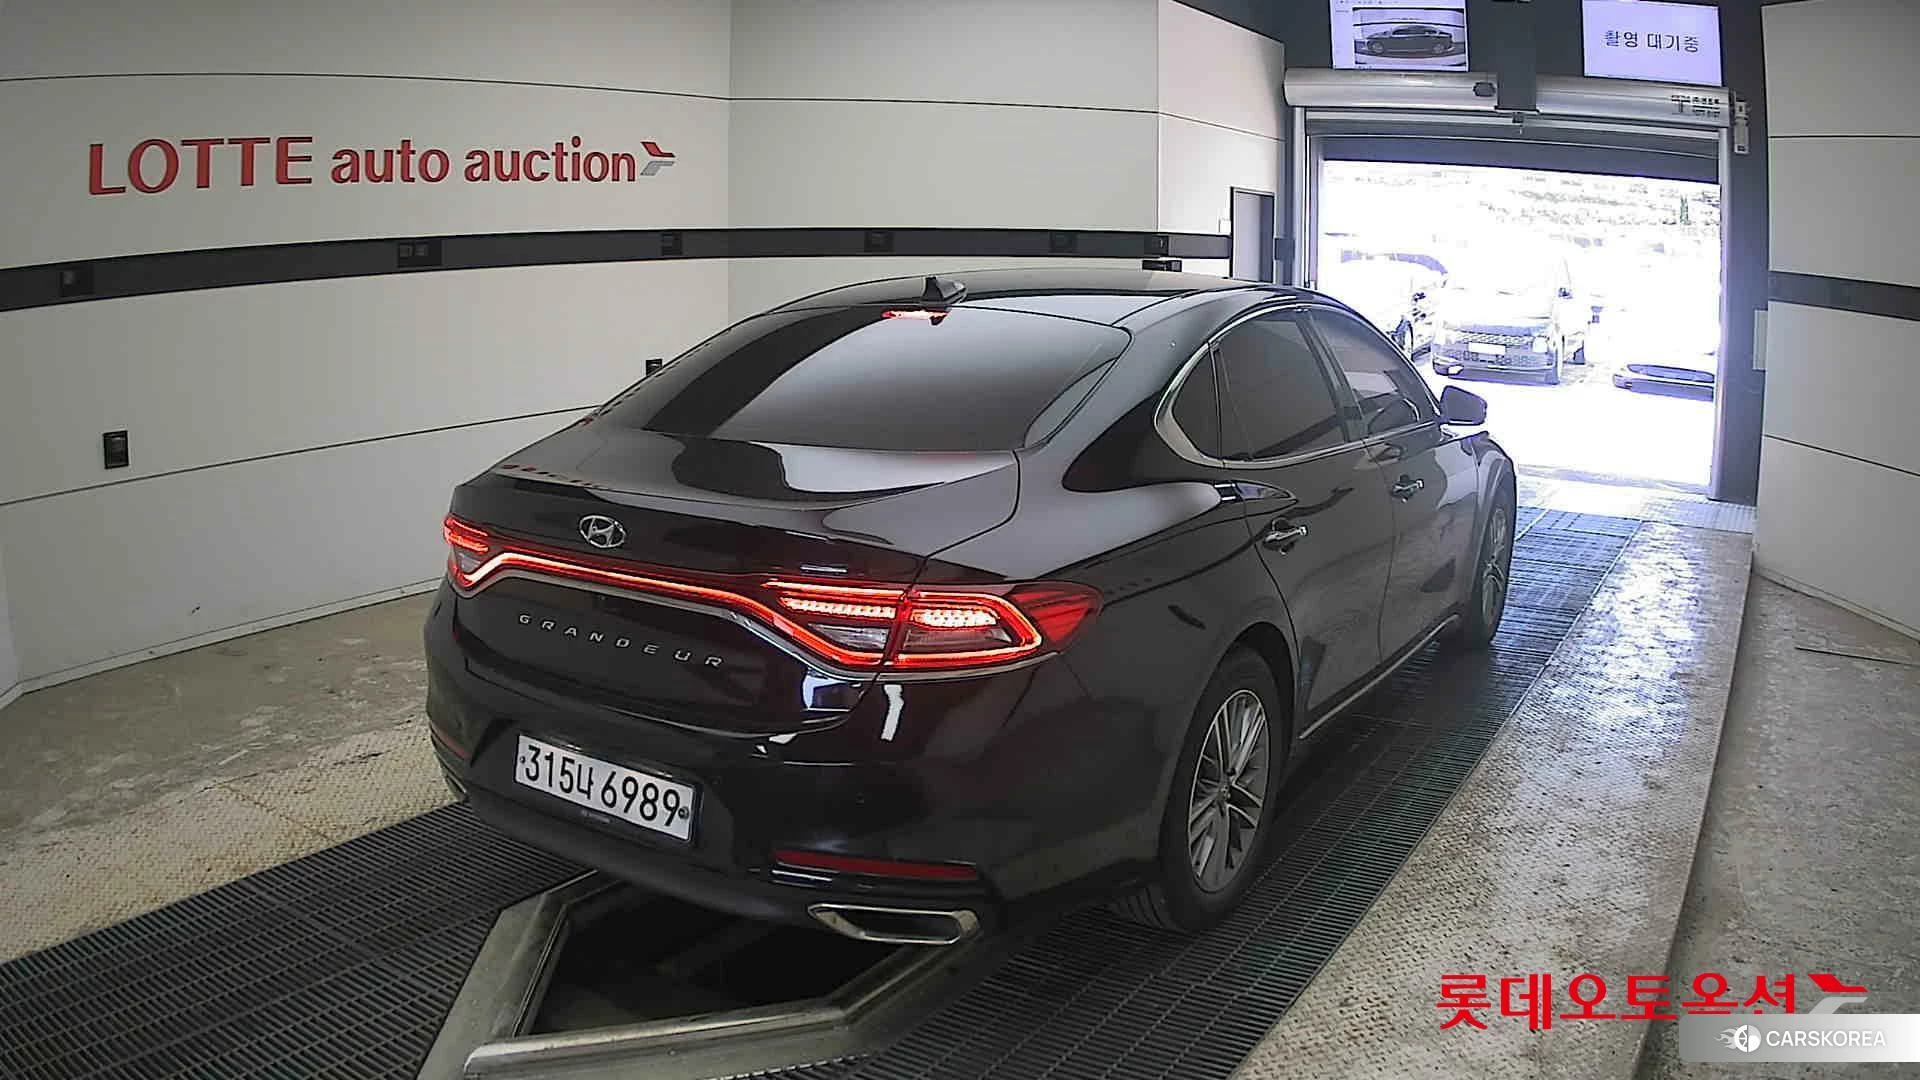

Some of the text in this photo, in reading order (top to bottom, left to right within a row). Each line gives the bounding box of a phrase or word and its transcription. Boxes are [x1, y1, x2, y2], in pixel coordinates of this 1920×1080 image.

[1604, 30, 1699, 53] 촬영 대기중
[89, 135, 637, 195] LOTTE auto auction
[518, 613, 724, 668] GRANDEUR
[525, 744, 681, 827] 315나 6989
